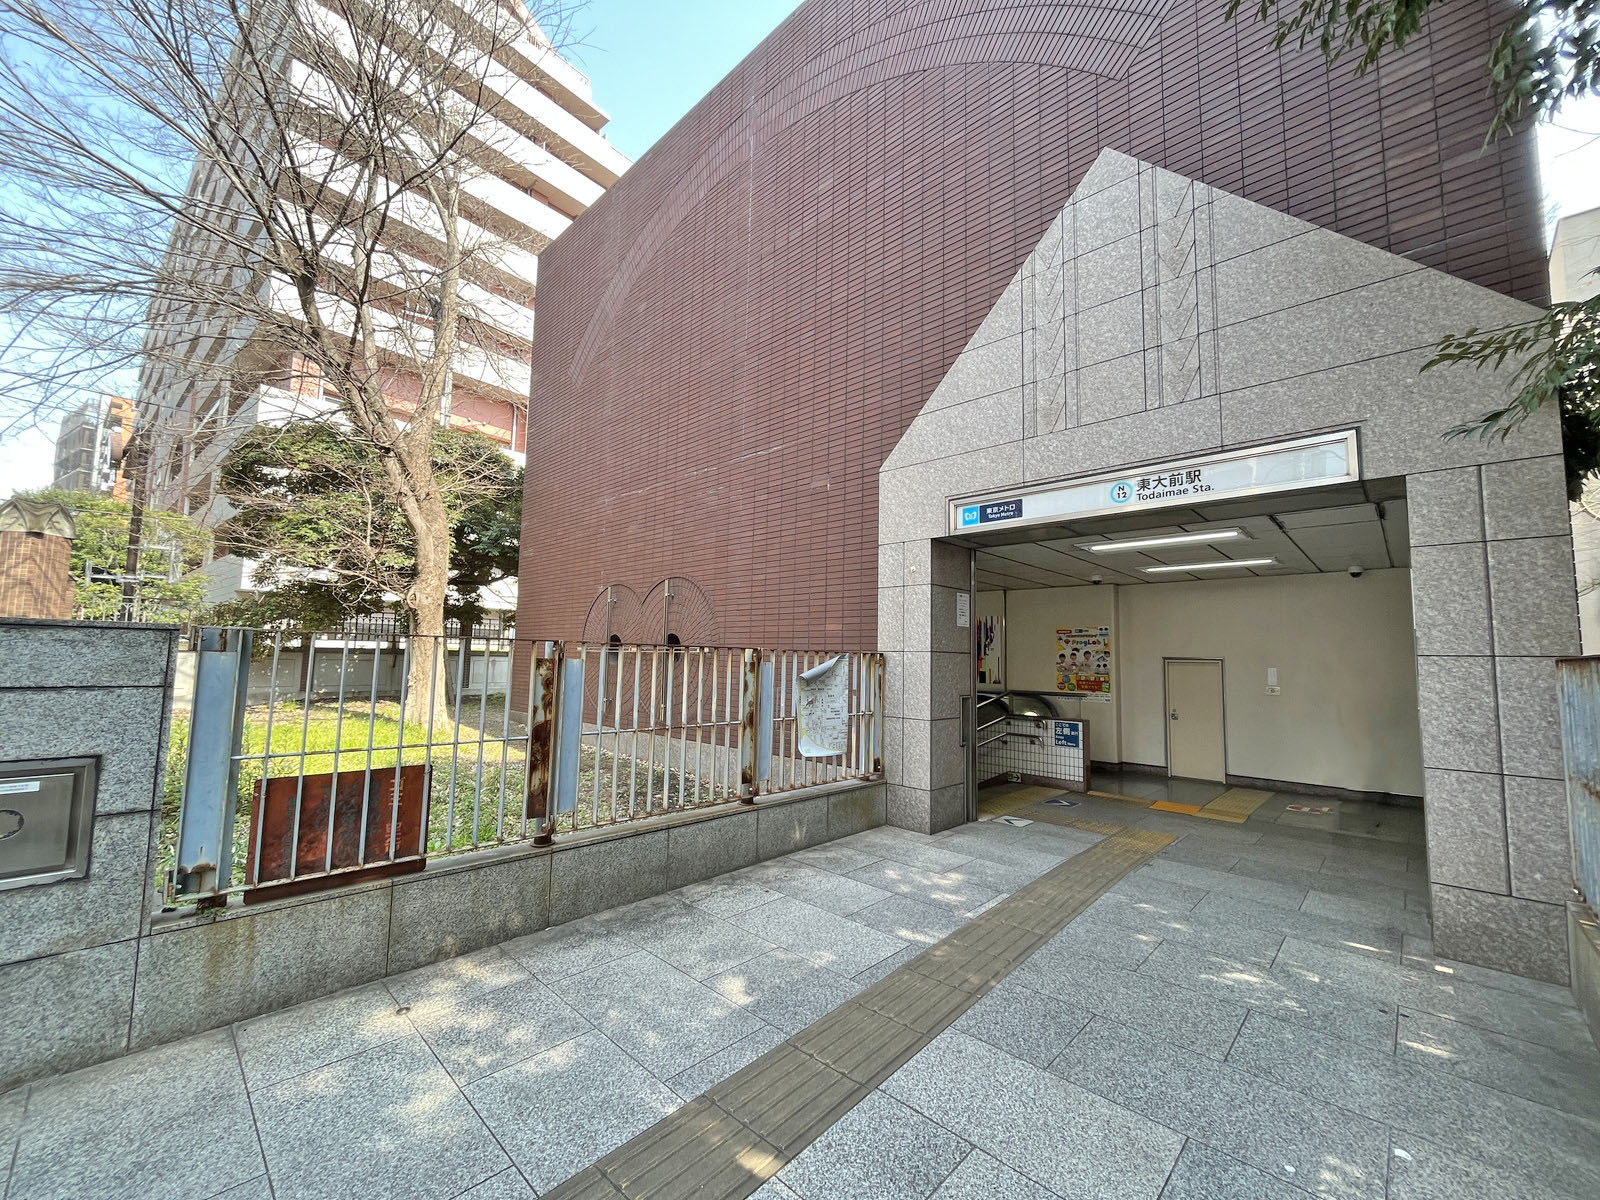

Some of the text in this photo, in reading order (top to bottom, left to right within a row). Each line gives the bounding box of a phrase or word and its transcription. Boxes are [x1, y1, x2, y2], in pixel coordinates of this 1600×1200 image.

[1136, 469, 1201, 492] 東大前駅
[1117, 491, 1127, 499] 12
[1136, 483, 1214, 501] Todaimae Sta.
[986, 503, 1016, 514] 東京メトロ
